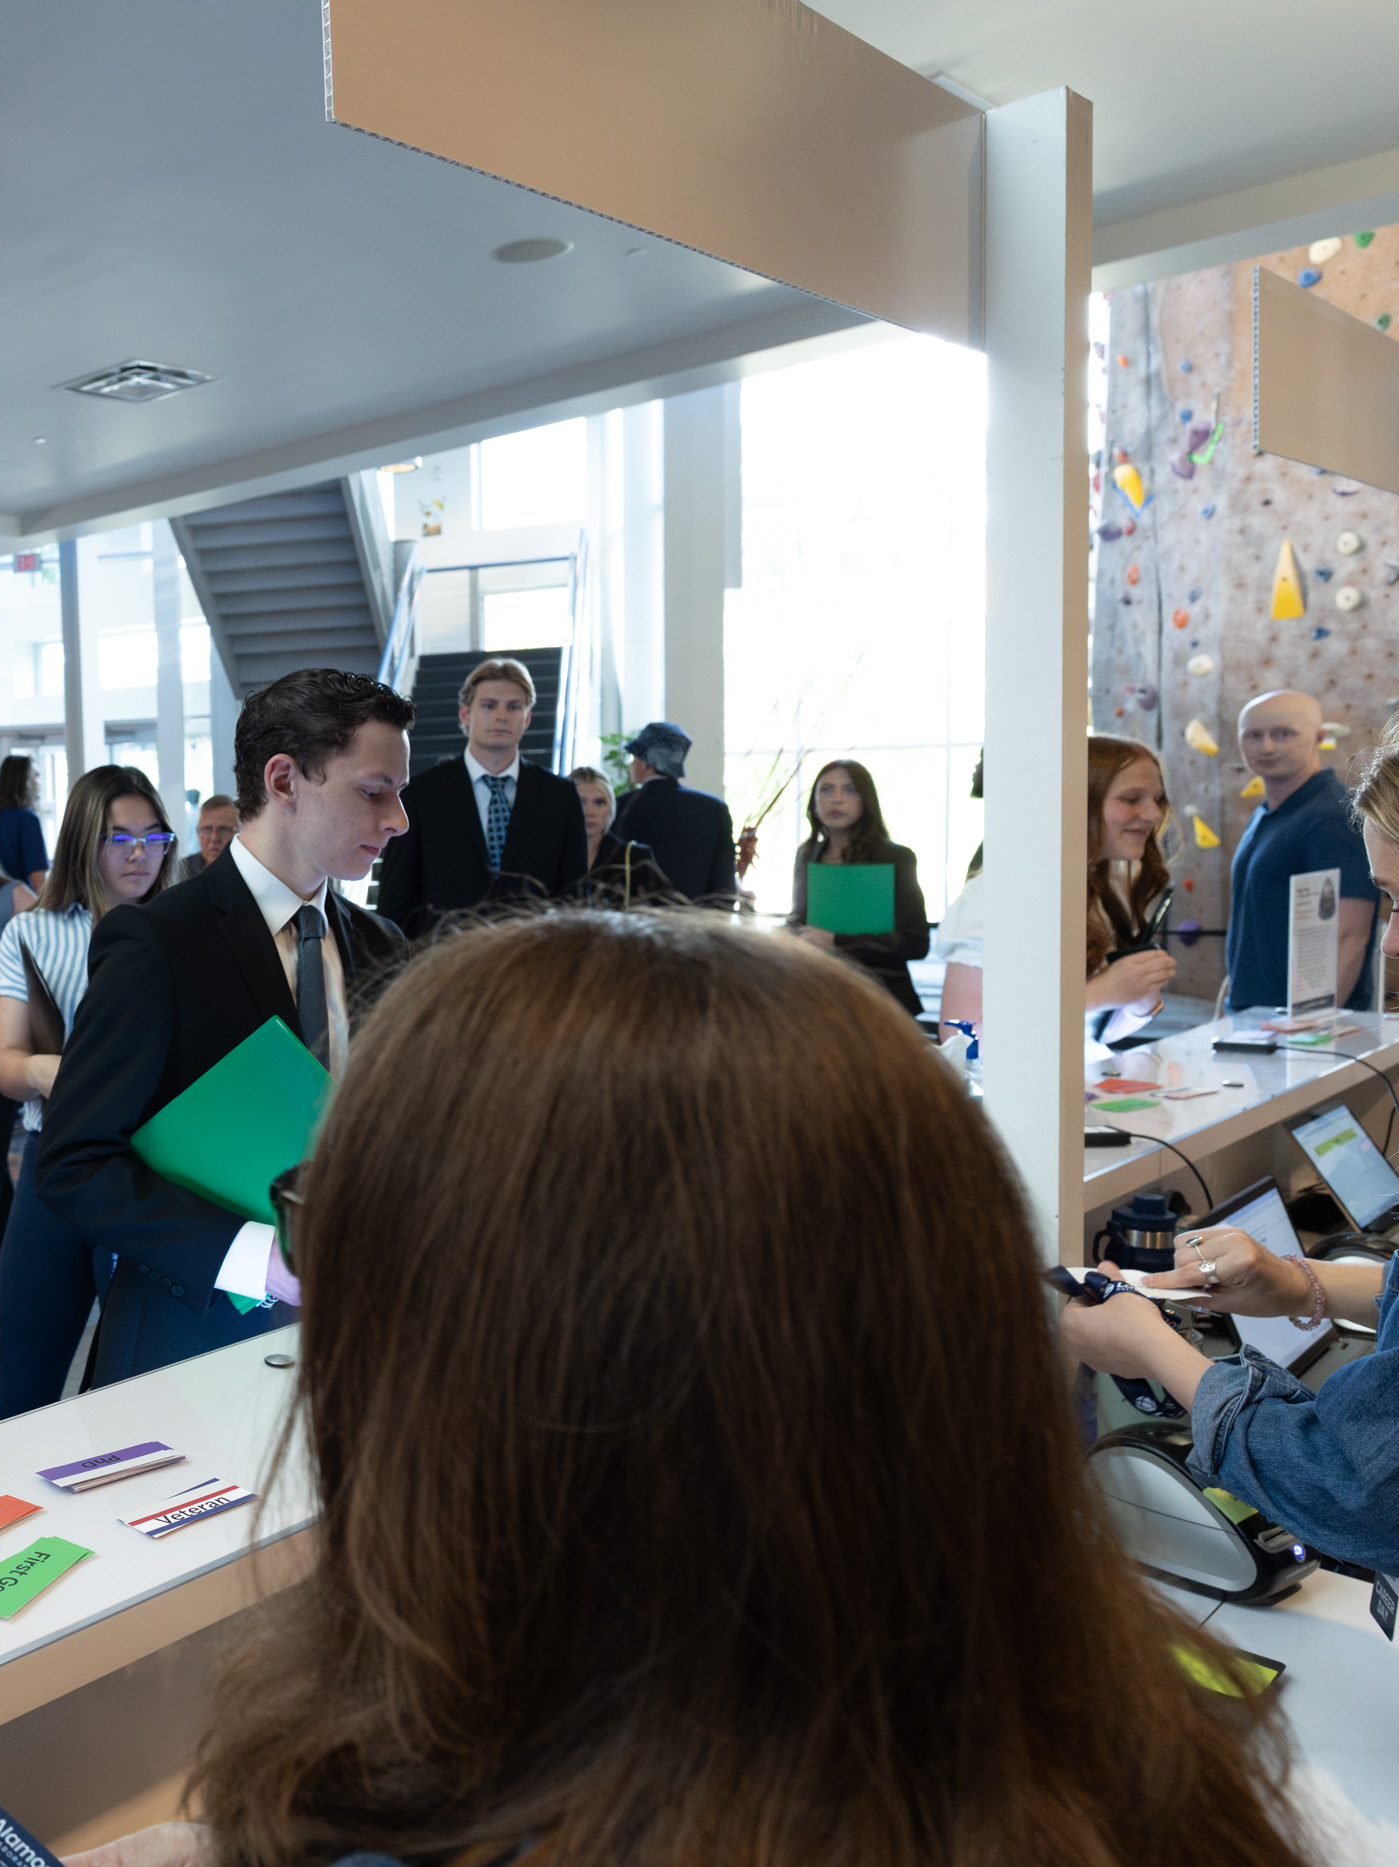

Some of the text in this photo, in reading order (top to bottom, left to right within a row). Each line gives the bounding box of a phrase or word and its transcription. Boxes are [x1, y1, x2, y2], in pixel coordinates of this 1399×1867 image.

[81, 1454, 121, 1469] PhD
[156, 1495, 231, 1525] Veteran
[9, 1551, 51, 1576] First
[1376, 1580, 1396, 1616] CAREER
[1377, 1598, 1389, 1622] DAY
